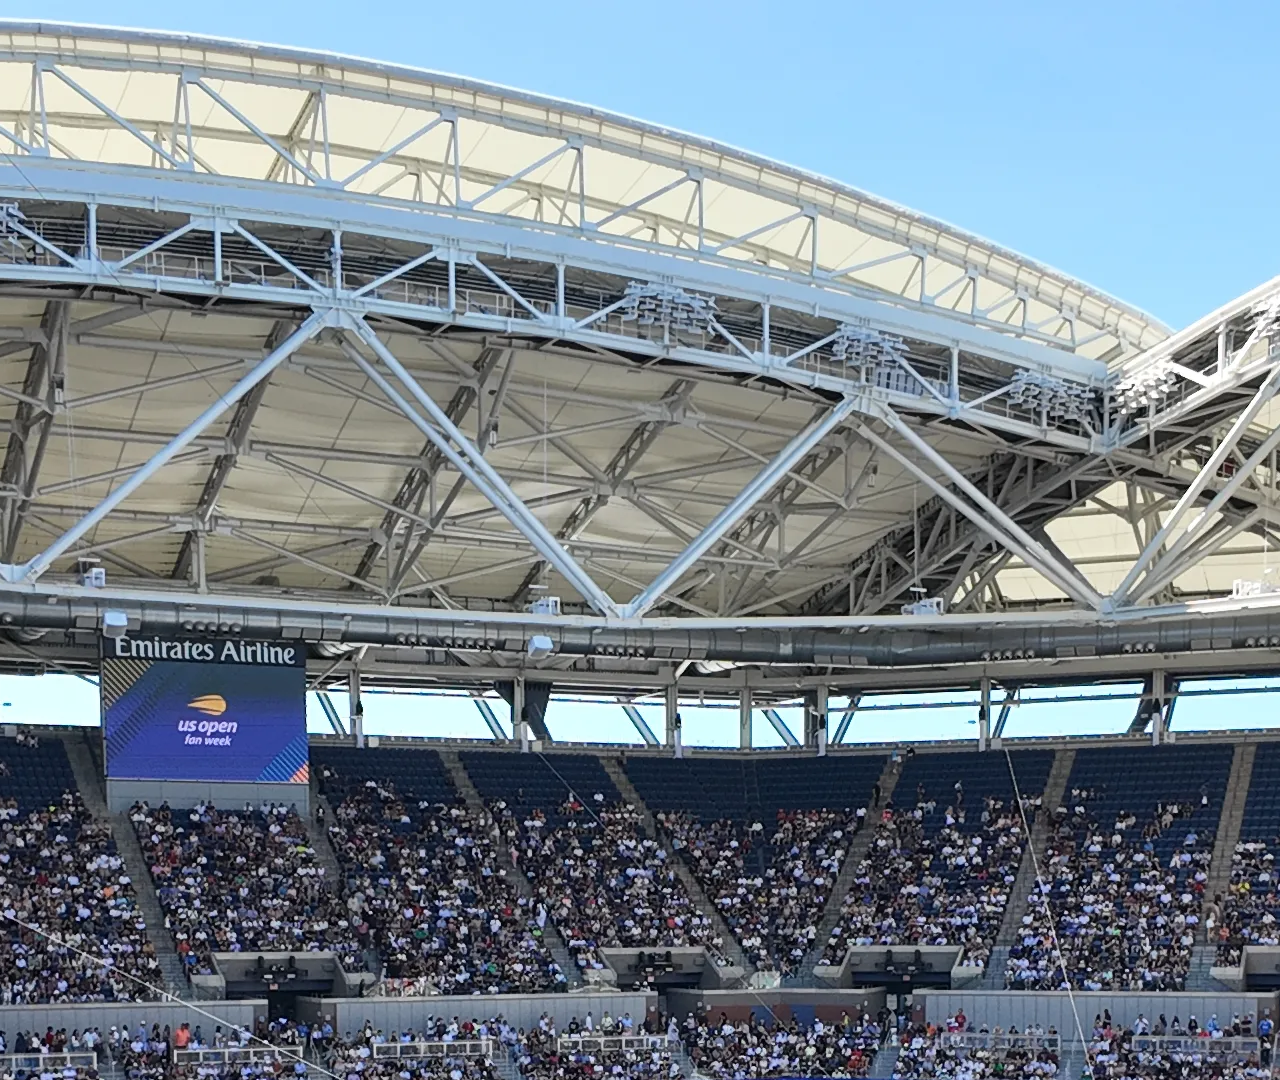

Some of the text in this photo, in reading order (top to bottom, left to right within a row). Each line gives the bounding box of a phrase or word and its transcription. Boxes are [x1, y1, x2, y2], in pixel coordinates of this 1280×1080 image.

[115, 636, 296, 665] Emirates Airline
[178, 720, 238, 736] us open
[184, 734, 232, 746] fan week
